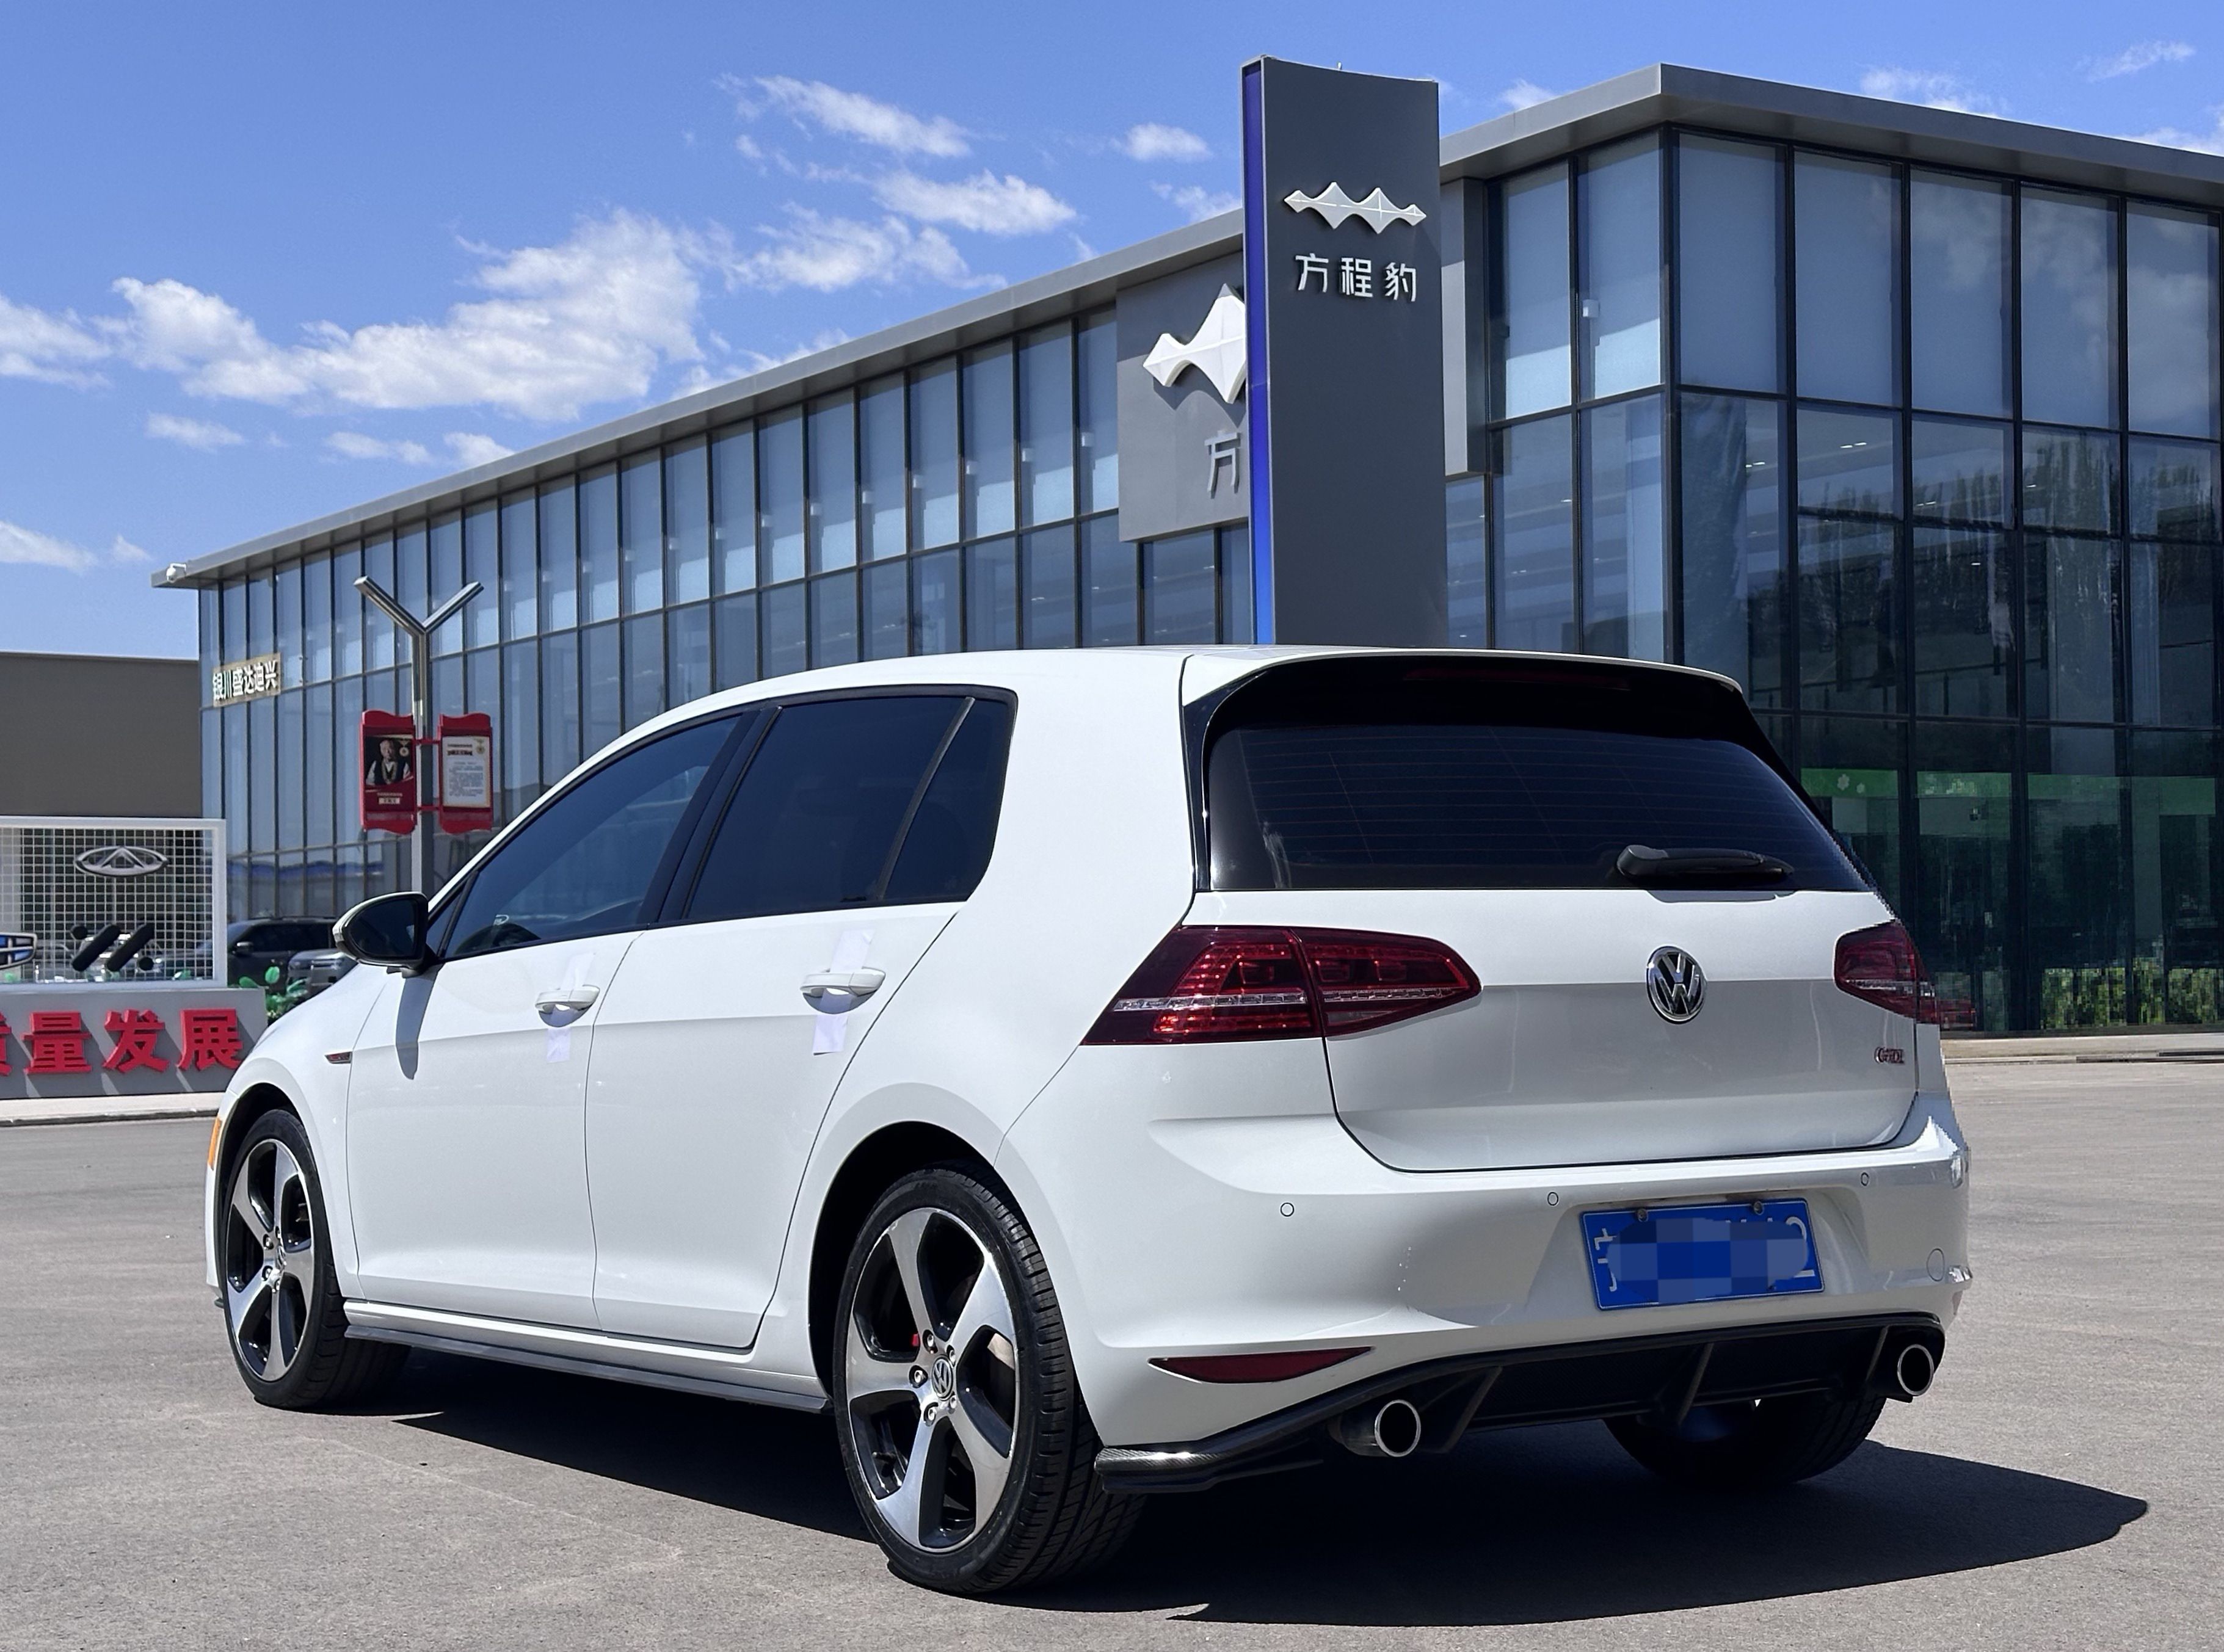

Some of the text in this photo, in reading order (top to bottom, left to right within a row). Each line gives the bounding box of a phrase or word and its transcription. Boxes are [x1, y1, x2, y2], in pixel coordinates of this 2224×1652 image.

[1295, 253, 1417, 302] 方程豹
[213, 659, 277, 701] 银川盛达迪兴
[0, 1008, 244, 1076] 量发展
